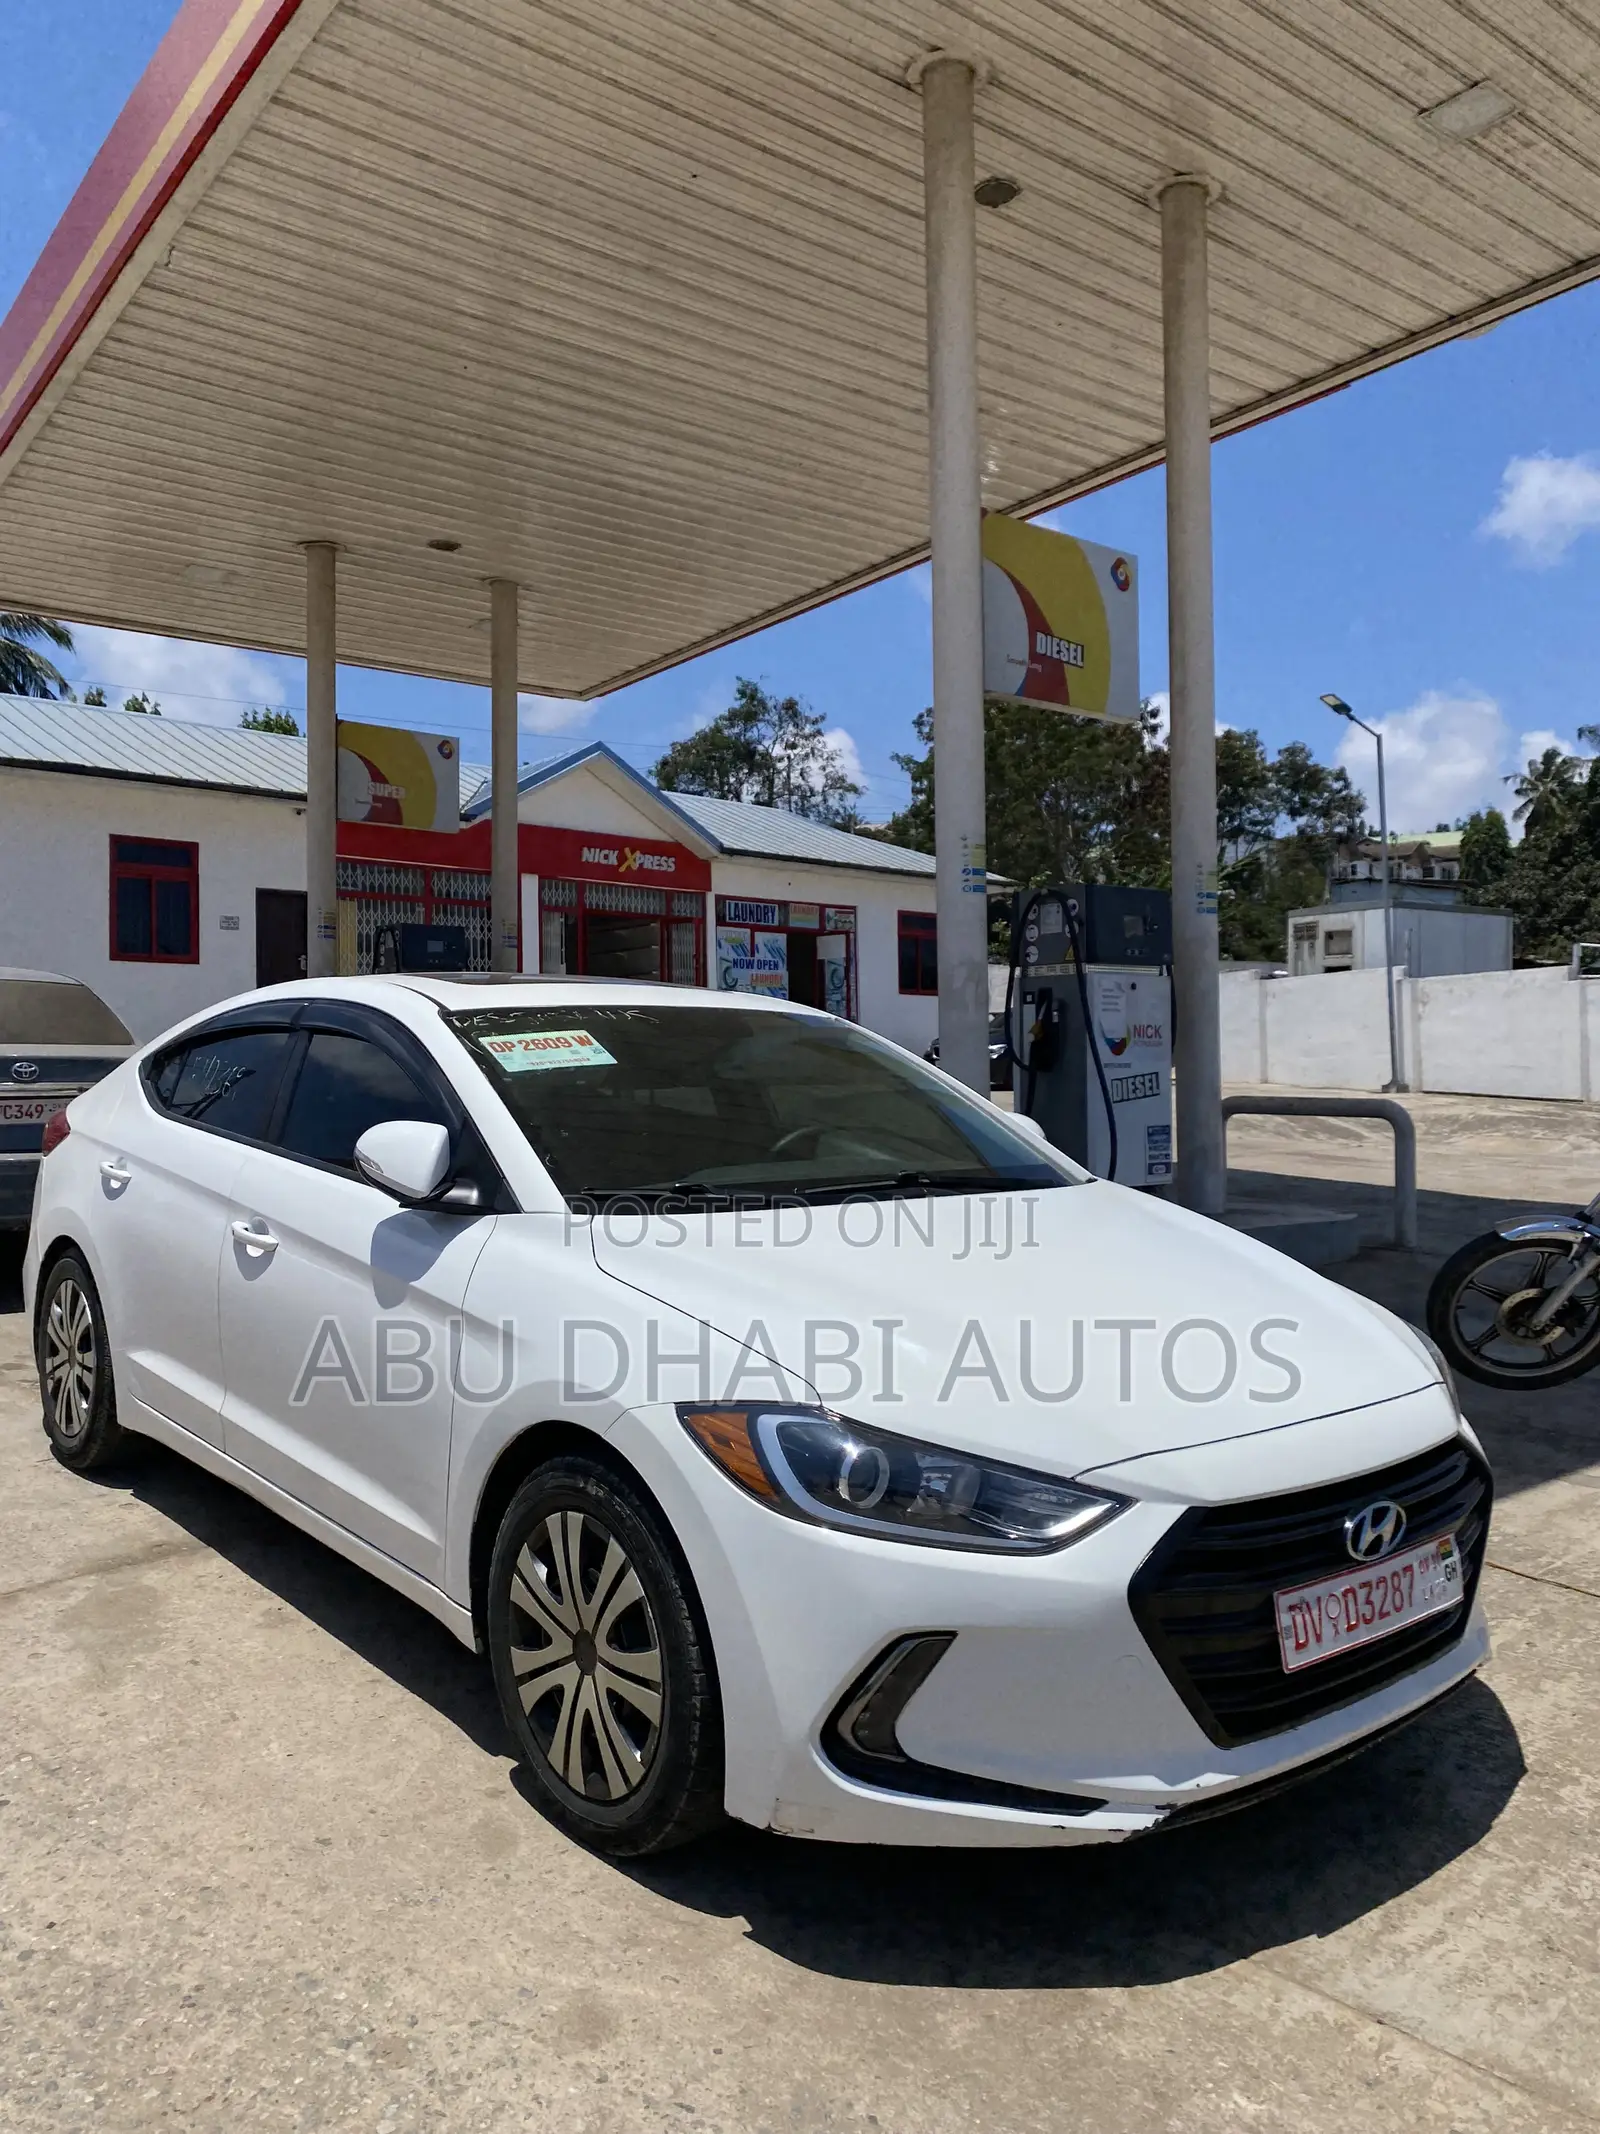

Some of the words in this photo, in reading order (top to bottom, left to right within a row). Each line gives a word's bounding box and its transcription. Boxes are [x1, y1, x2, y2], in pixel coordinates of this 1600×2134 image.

[1036, 631, 1084, 668] DIESEL
[368, 781, 406, 799] SUPER
[582, 847, 619, 865] NICK
[619, 847, 675, 872] XPRESS
[727, 901, 776, 925] LAUNDRY
[732, 957, 755, 970] NOW
[756, 959, 779, 971] OPEN
[1133, 1024, 1162, 1039] NICK
[517, 1036, 573, 1052] 2609
[571, 1034, 594, 1047] W
[1112, 1072, 1160, 1103] DIESEL
[1444, 1560, 1458, 1582] GH
